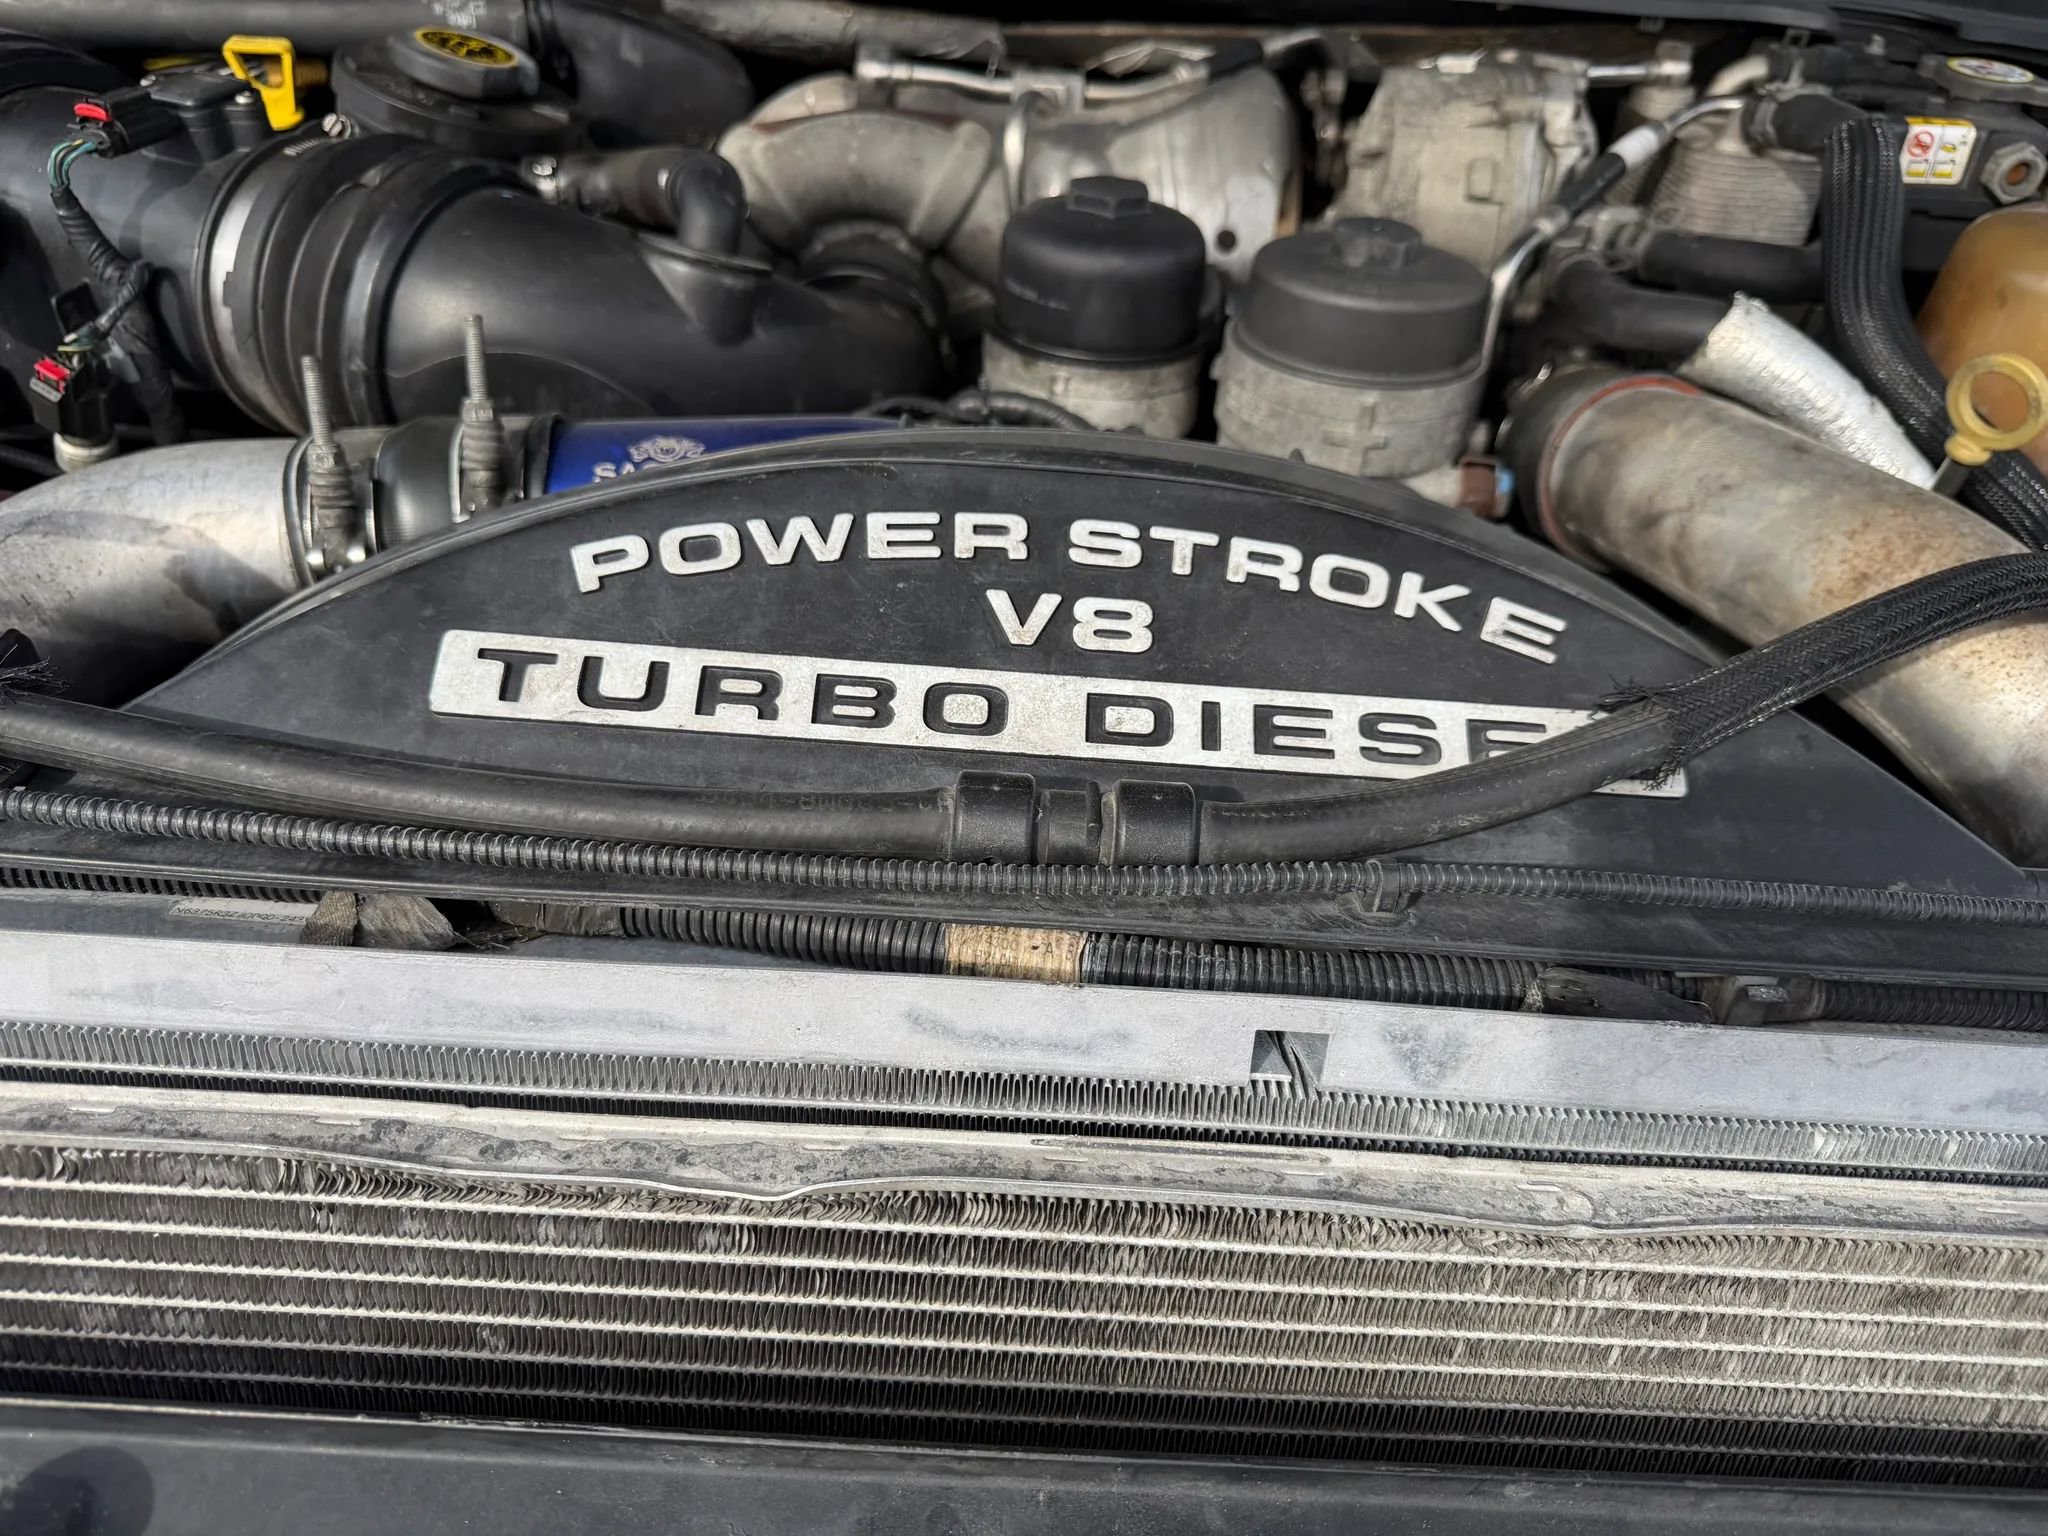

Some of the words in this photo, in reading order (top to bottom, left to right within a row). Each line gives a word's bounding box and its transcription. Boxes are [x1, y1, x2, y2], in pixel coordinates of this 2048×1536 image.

[570, 511, 1029, 594] POWER
[1068, 518, 1567, 665] STROKE
[985, 587, 1154, 654] V8
[477, 647, 1009, 737] TURBO
[1085, 691, 1658, 780] DIESE
